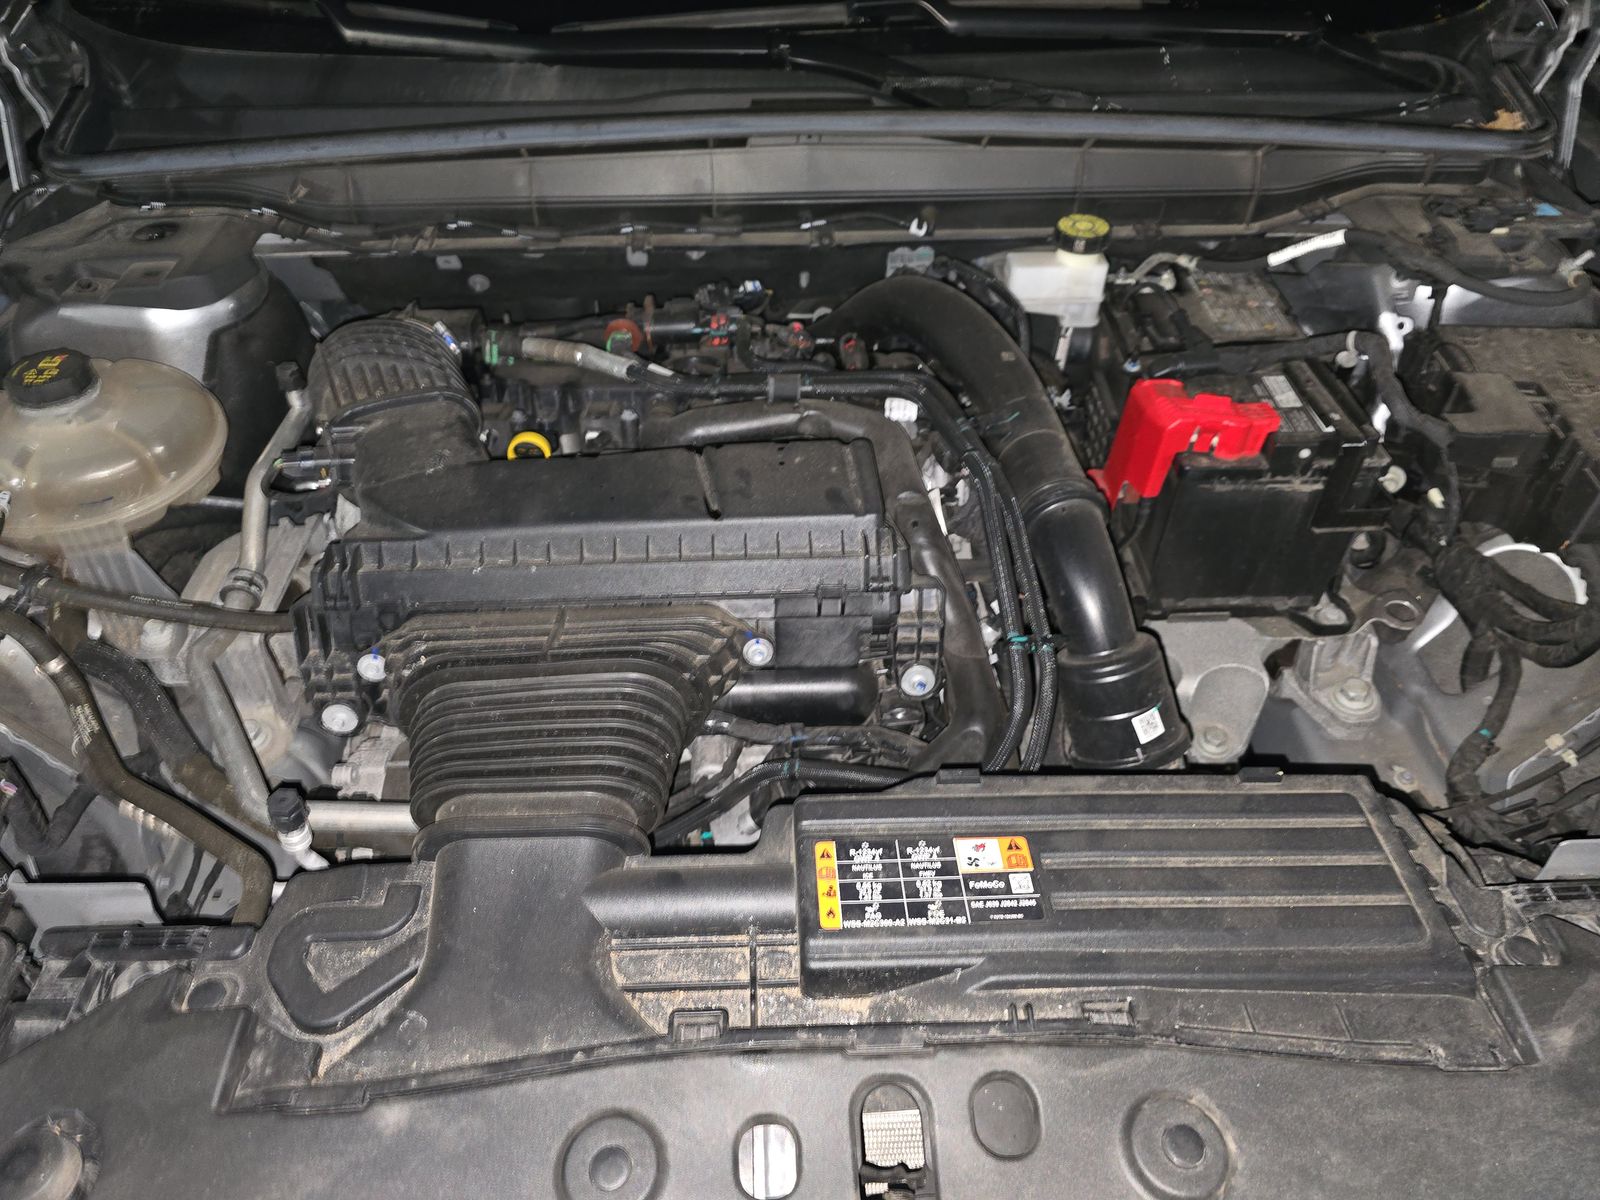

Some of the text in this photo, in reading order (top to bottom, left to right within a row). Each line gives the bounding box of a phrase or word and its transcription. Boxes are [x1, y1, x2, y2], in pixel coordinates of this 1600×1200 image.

[851, 863, 883, 872] NAUTILUS
[910, 861, 942, 870] NAUTILUS
[968, 879, 1006, 890] FoMoCo
[970, 900, 985, 909] SAE
